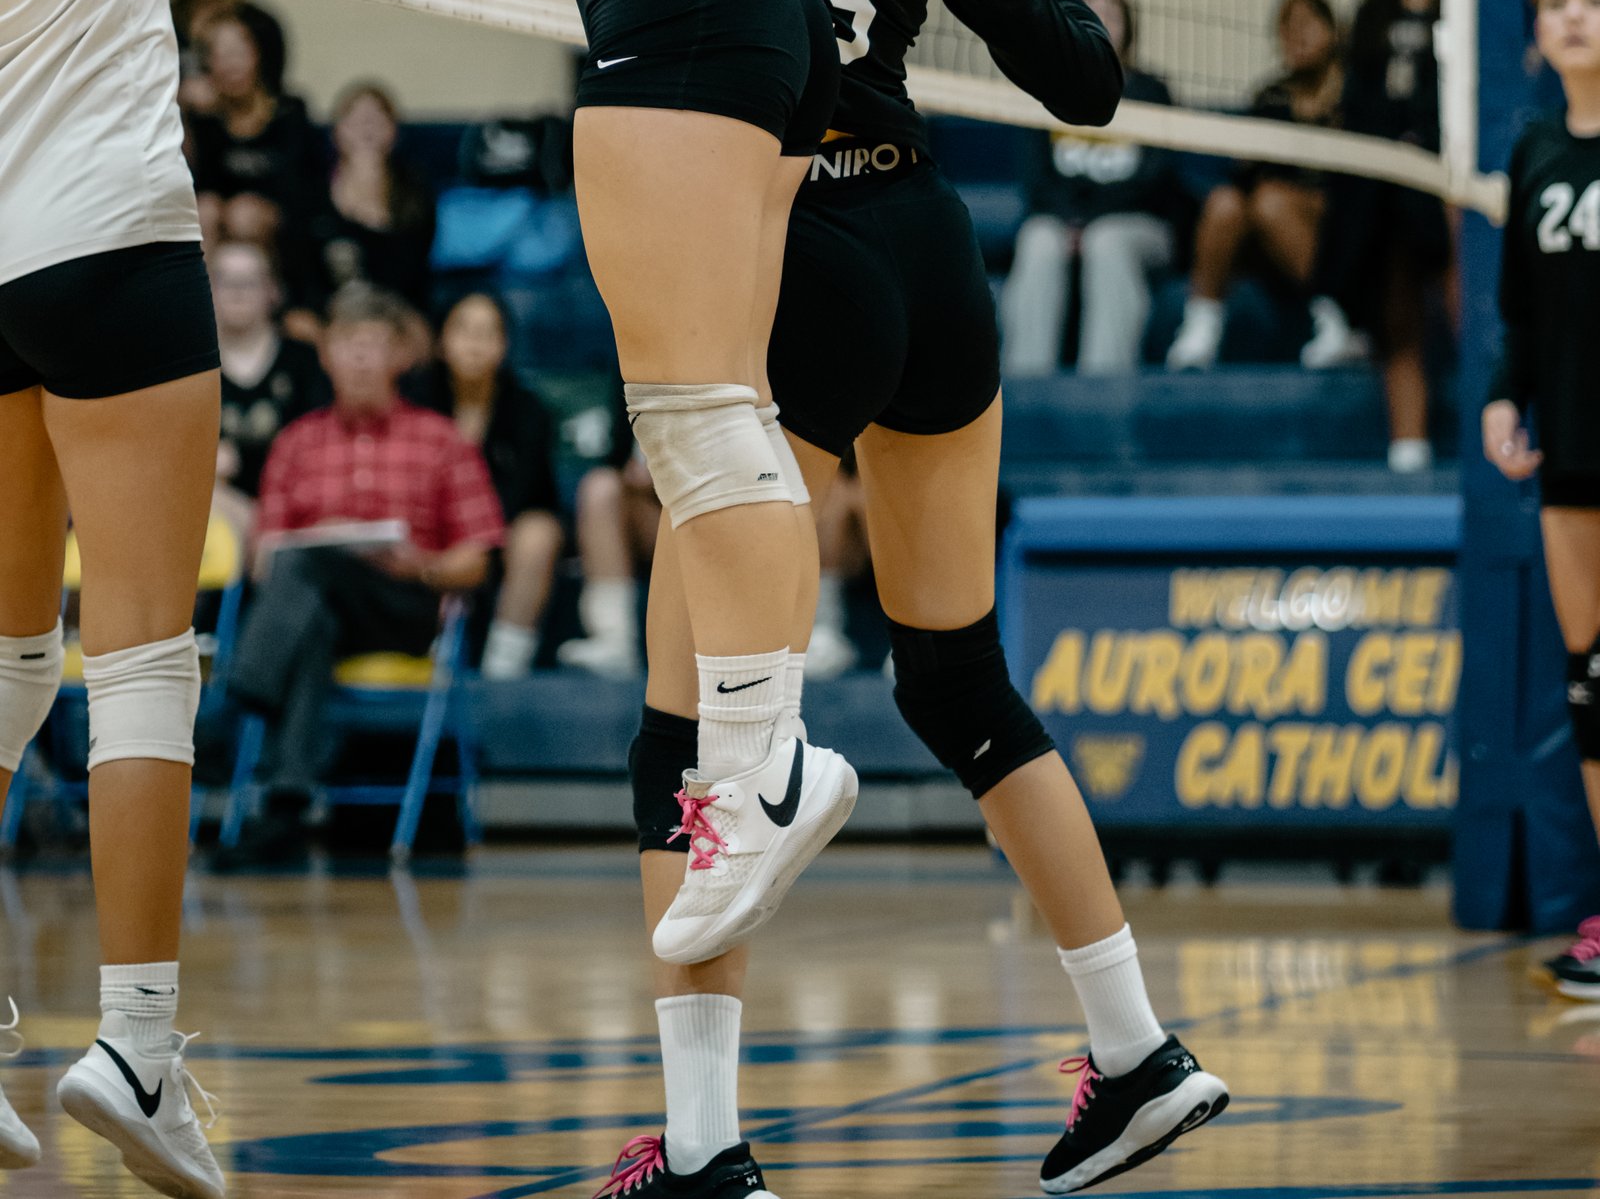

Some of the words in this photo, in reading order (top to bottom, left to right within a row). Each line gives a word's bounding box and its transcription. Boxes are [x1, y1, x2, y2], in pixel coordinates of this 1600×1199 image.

[1537, 179, 1600, 254] 24
[1170, 566, 1450, 628] WELCOME
[1034, 629, 1328, 718] AURORA
